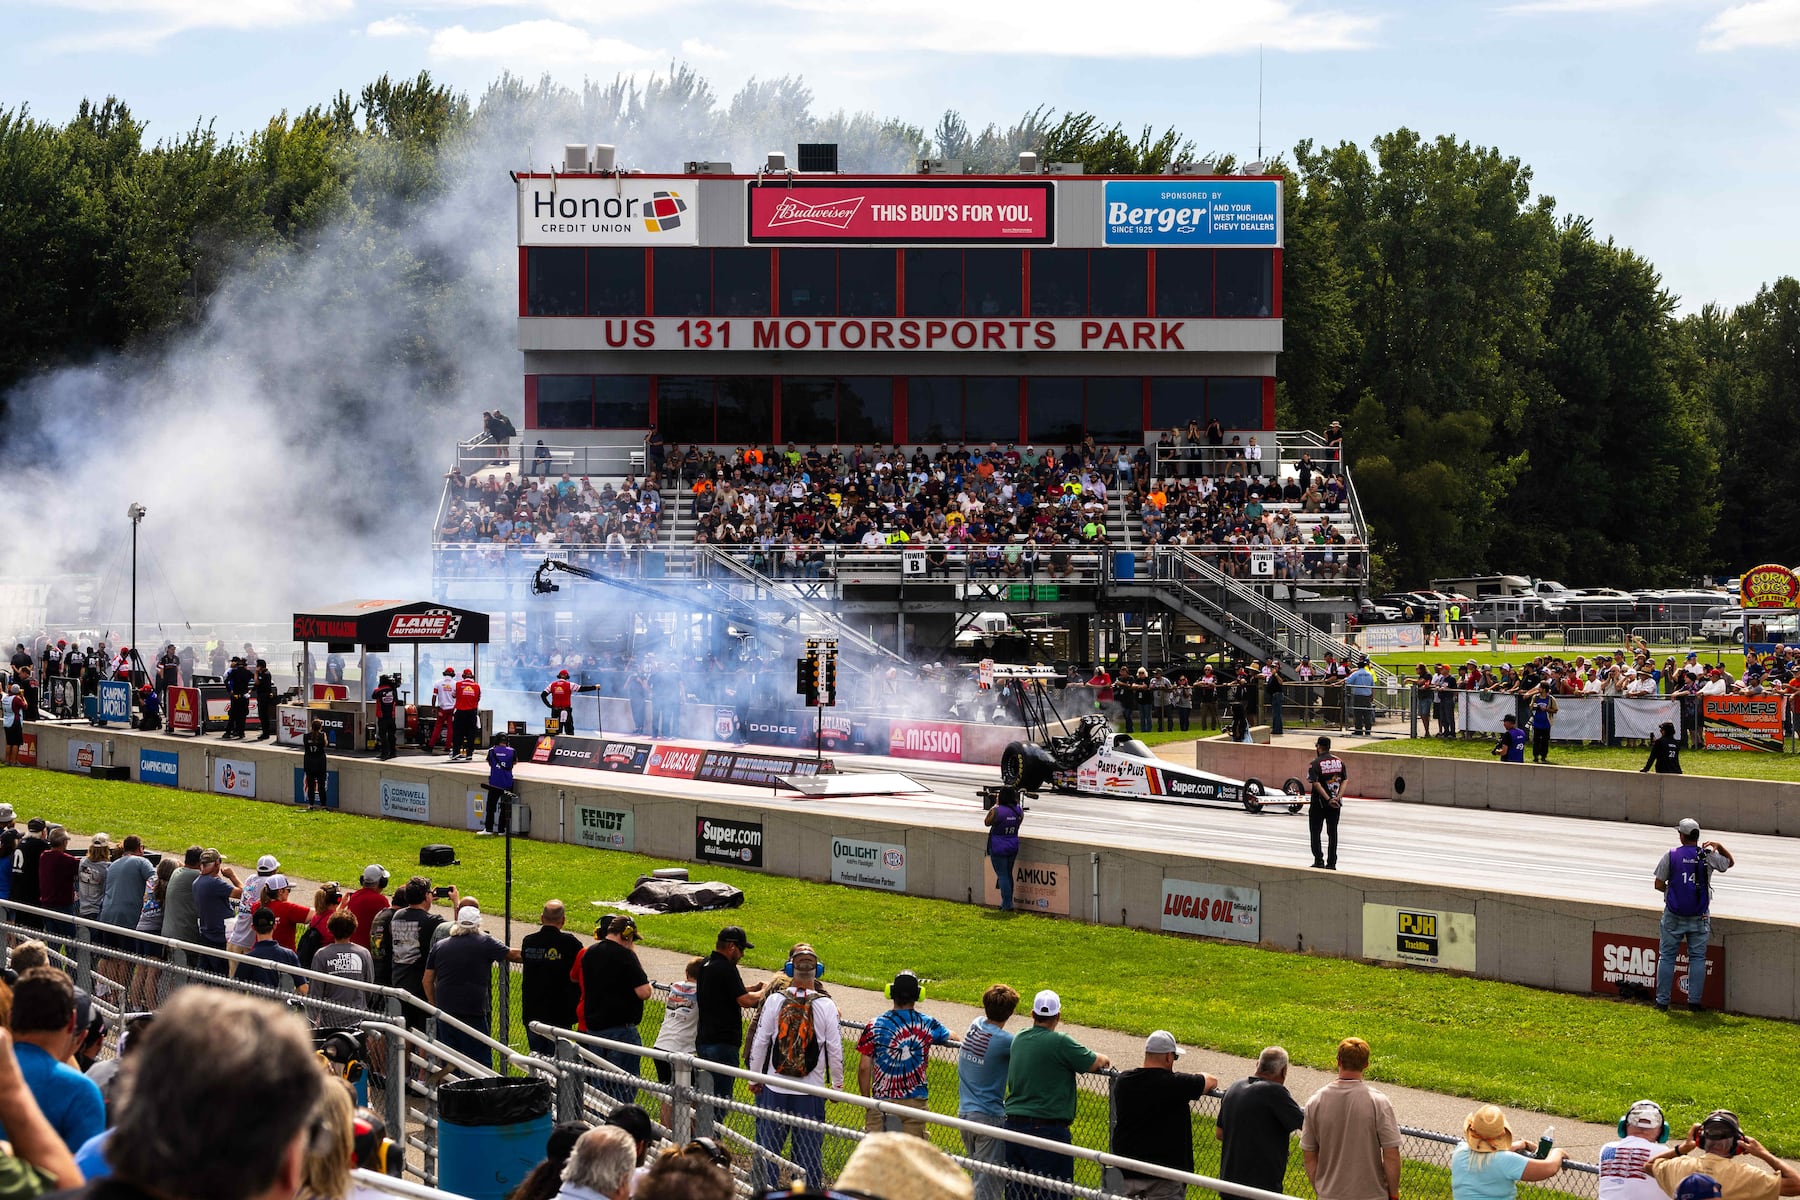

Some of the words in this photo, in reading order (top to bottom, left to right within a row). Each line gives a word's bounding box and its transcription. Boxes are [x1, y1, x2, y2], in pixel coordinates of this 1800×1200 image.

[1161, 192, 1207, 200] SPONSORED
[1212, 192, 1222, 200] BY
[535, 191, 639, 218] Honor
[1213, 204, 1229, 212] AND
[1231, 204, 1251, 212] YOUR
[776, 203, 854, 220] Budweiser
[871, 205, 907, 222] THIS
[911, 205, 958, 222] BUD'S
[962, 205, 993, 222] FOR
[997, 205, 1033, 222] YOU.
[1108, 202, 1207, 233] Berger
[1213, 213, 1234, 221] WEST
[1237, 213, 1274, 221] MICHIGAN
[541, 224, 587, 233] CREDIT
[592, 224, 632, 233] UNION
[1111, 226, 1134, 234] SINCE
[1135, 226, 1153, 234] 1925
[1213, 223, 1238, 231] CHEVY
[1240, 223, 1275, 231] DEALERS
[604, 319, 656, 348] US
[677, 320, 731, 348] 131
[753, 320, 1056, 349] MOTORSPORTS
[1081, 321, 1185, 350] PARK
[1252, 553, 1273, 561] TOWER
[911, 560, 920, 571] B
[1258, 561, 1268, 573] C
[1750, 572, 1791, 585] CORN
[1750, 582, 1791, 595] DOGS
[396, 618, 447, 628] LANE
[102, 684, 127, 700] CAMPING
[103, 699, 127, 717] WORLD
[1706, 702, 1777, 715] PLUMMERS
[317, 719, 344, 728] ODGE
[1742, 714, 1779, 723] DISPOSAL
[749, 723, 798, 735] DODGE
[906, 728, 961, 754] MISSION
[555, 748, 592, 759] DODGE
[140, 759, 161, 773] CAMPING
[160, 760, 178, 775] WORLD
[661, 751, 689, 770] LUCAS
[684, 753, 701, 772] OIL
[1319, 759, 1343, 770] SCAG
[1097, 760, 1117, 774] PARTS
[1127, 763, 1145, 777] PLUS
[1171, 779, 1214, 795] Super.com
[391, 788, 426, 800] CORNWELL
[581, 808, 626, 831] FENDT
[703, 820, 762, 846] Super.com
[842, 845, 879, 860] OLIGHT
[1016, 867, 1056, 886] AMKUS
[1682, 872, 1696, 884] 14
[1163, 893, 1210, 921] LUCAS
[1211, 899, 1234, 923] OIL
[1399, 913, 1435, 936] PJH
[327, 959, 350, 967] NORTH
[1603, 943, 1656, 977] SCAG
